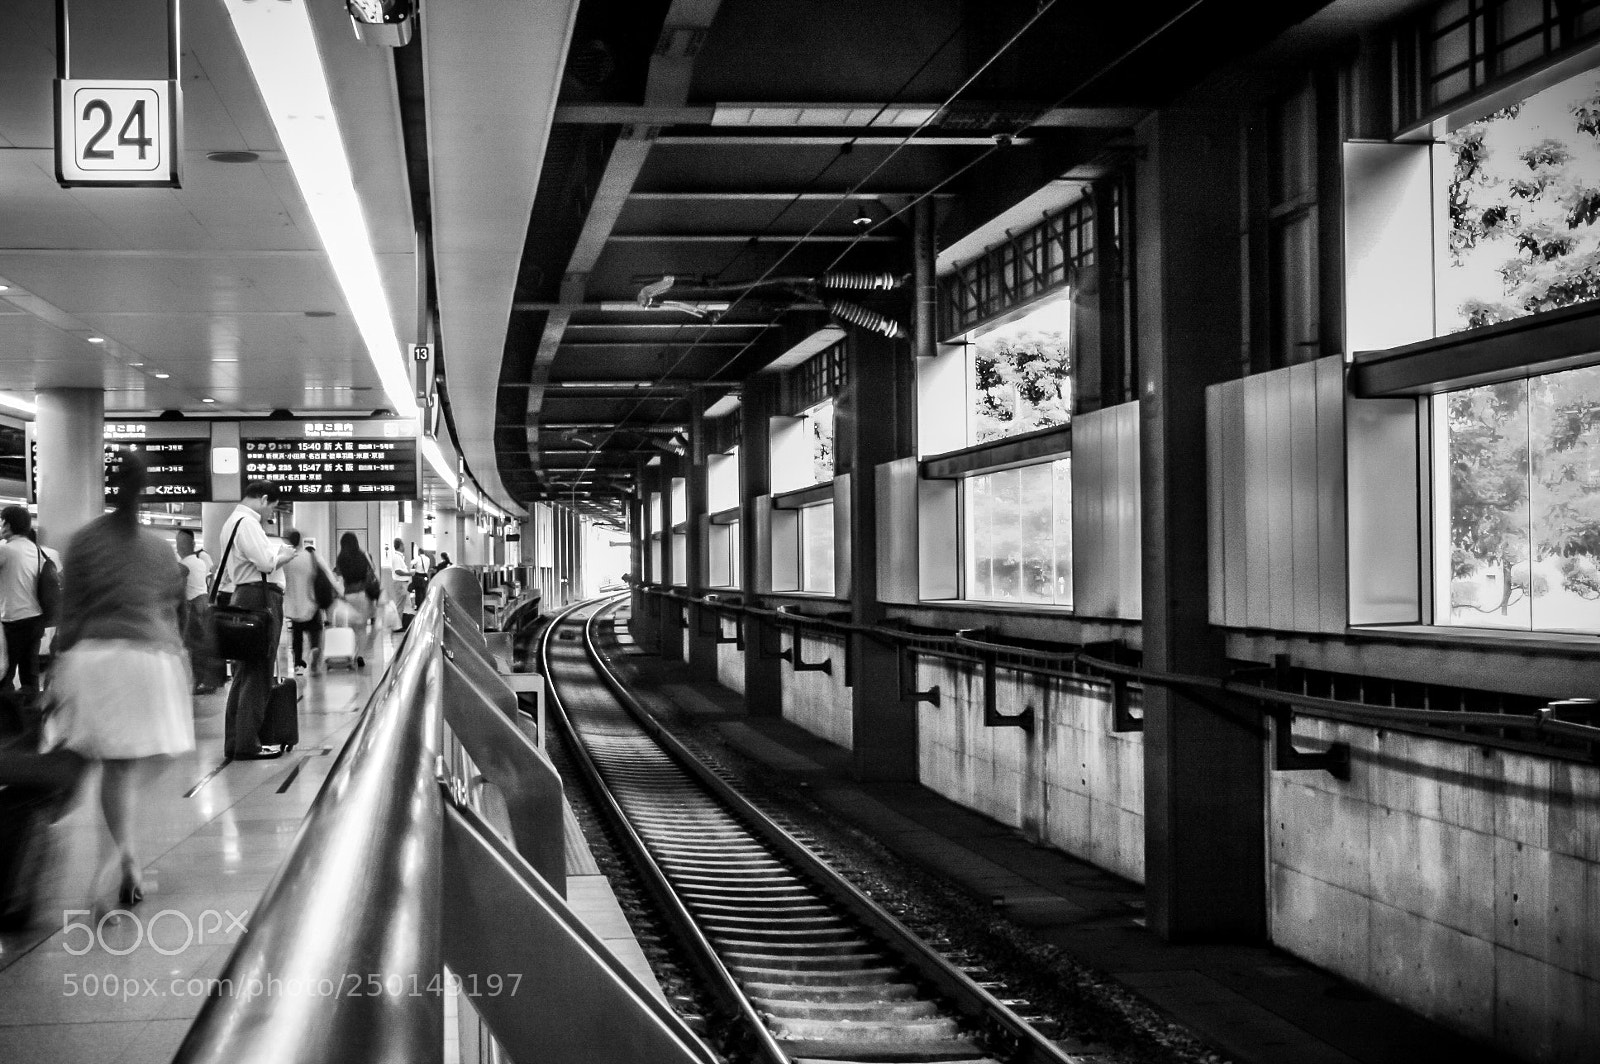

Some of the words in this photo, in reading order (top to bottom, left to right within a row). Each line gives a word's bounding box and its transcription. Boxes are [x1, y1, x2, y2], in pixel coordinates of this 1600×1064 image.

[82, 98, 153, 160] 24
[415, 348, 427, 360] 13
[246, 442, 276, 451] ひかり
[298, 442, 321, 451] 15:40
[324, 442, 354, 451] 新大阪
[246, 463, 276, 472] のぞみ
[298, 463, 321, 472] 15:47
[324, 463, 354, 472] 新大阪
[298, 484, 322, 493] 15:57
